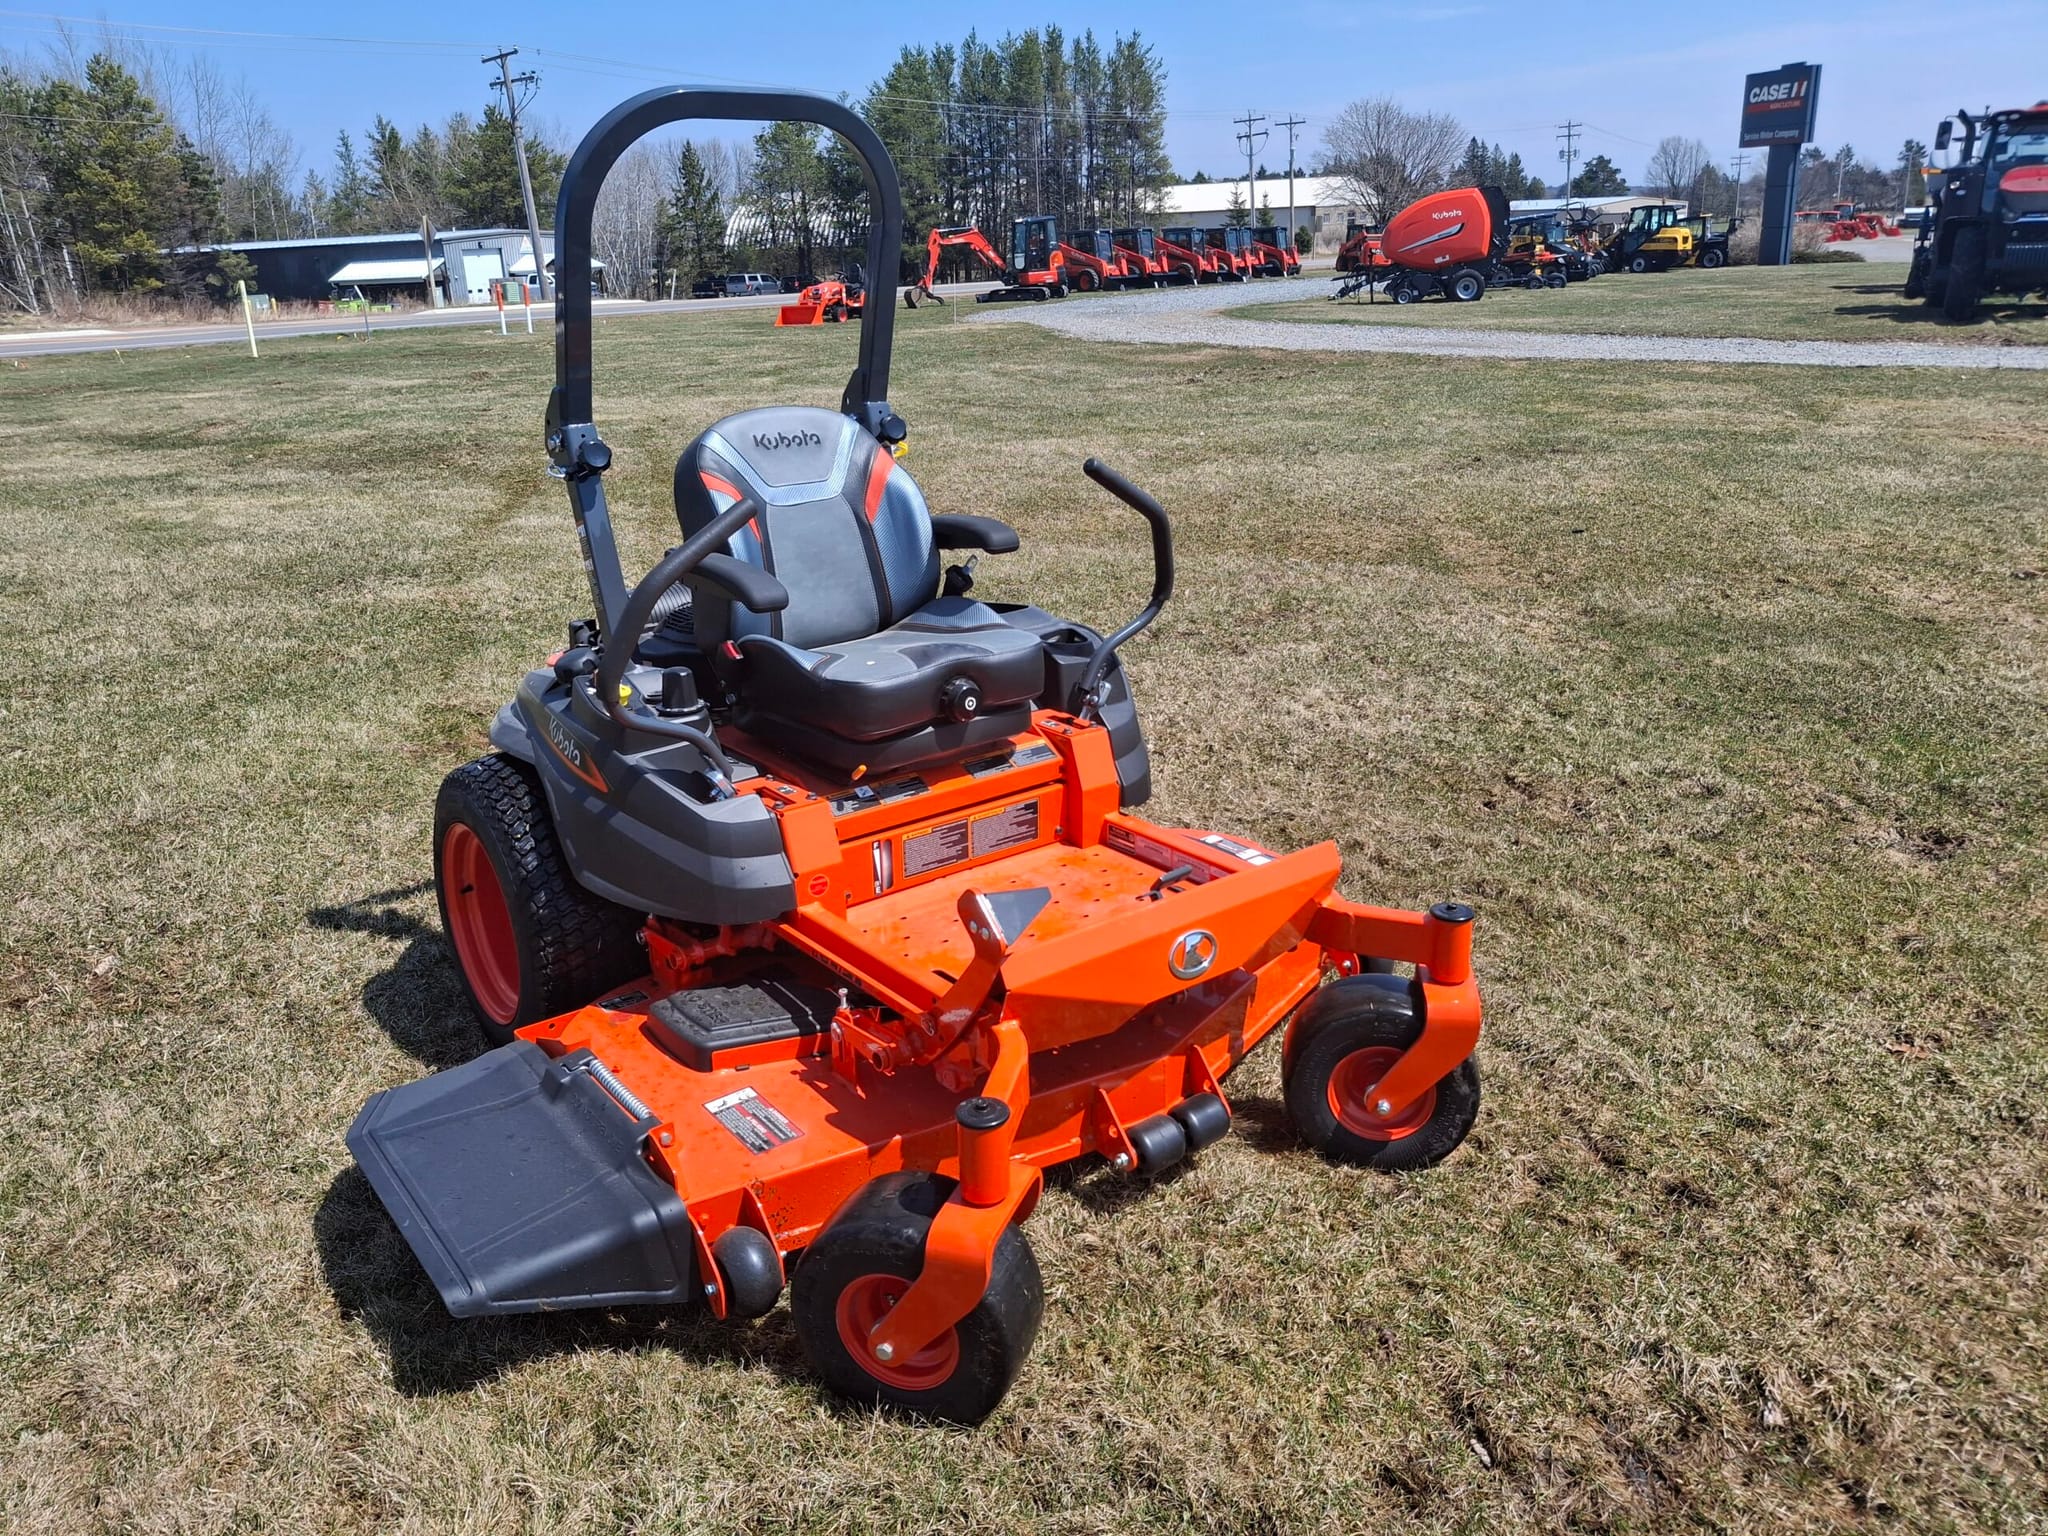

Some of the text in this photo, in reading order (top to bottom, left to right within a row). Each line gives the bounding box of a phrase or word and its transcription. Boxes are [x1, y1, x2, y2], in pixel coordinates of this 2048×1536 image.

[1749, 83, 1791, 103] CASE
[1774, 129, 1799, 139] Company
[1432, 209, 1462, 219] Kubota
[752, 429, 822, 450] Kubota
[549, 715, 581, 768] Kubota
